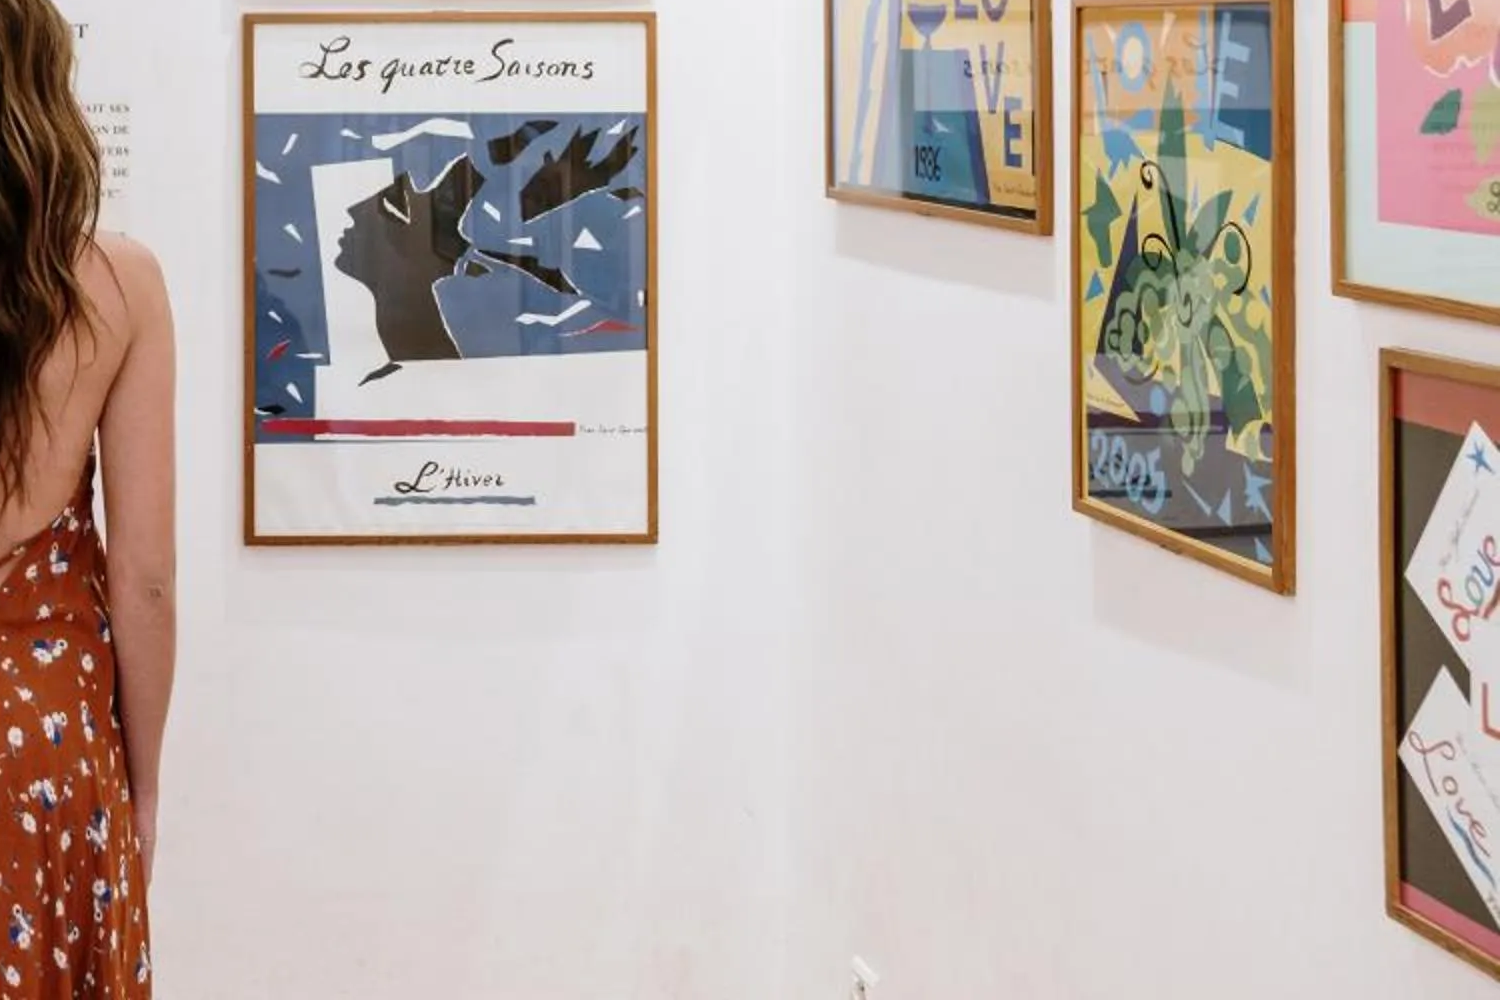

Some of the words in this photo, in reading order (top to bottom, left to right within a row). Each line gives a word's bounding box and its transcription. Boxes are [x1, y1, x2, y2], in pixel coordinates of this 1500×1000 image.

[300, 36, 371, 81] Les
[380, 56, 475, 94] quatre
[476, 38, 594, 83] Saisons
